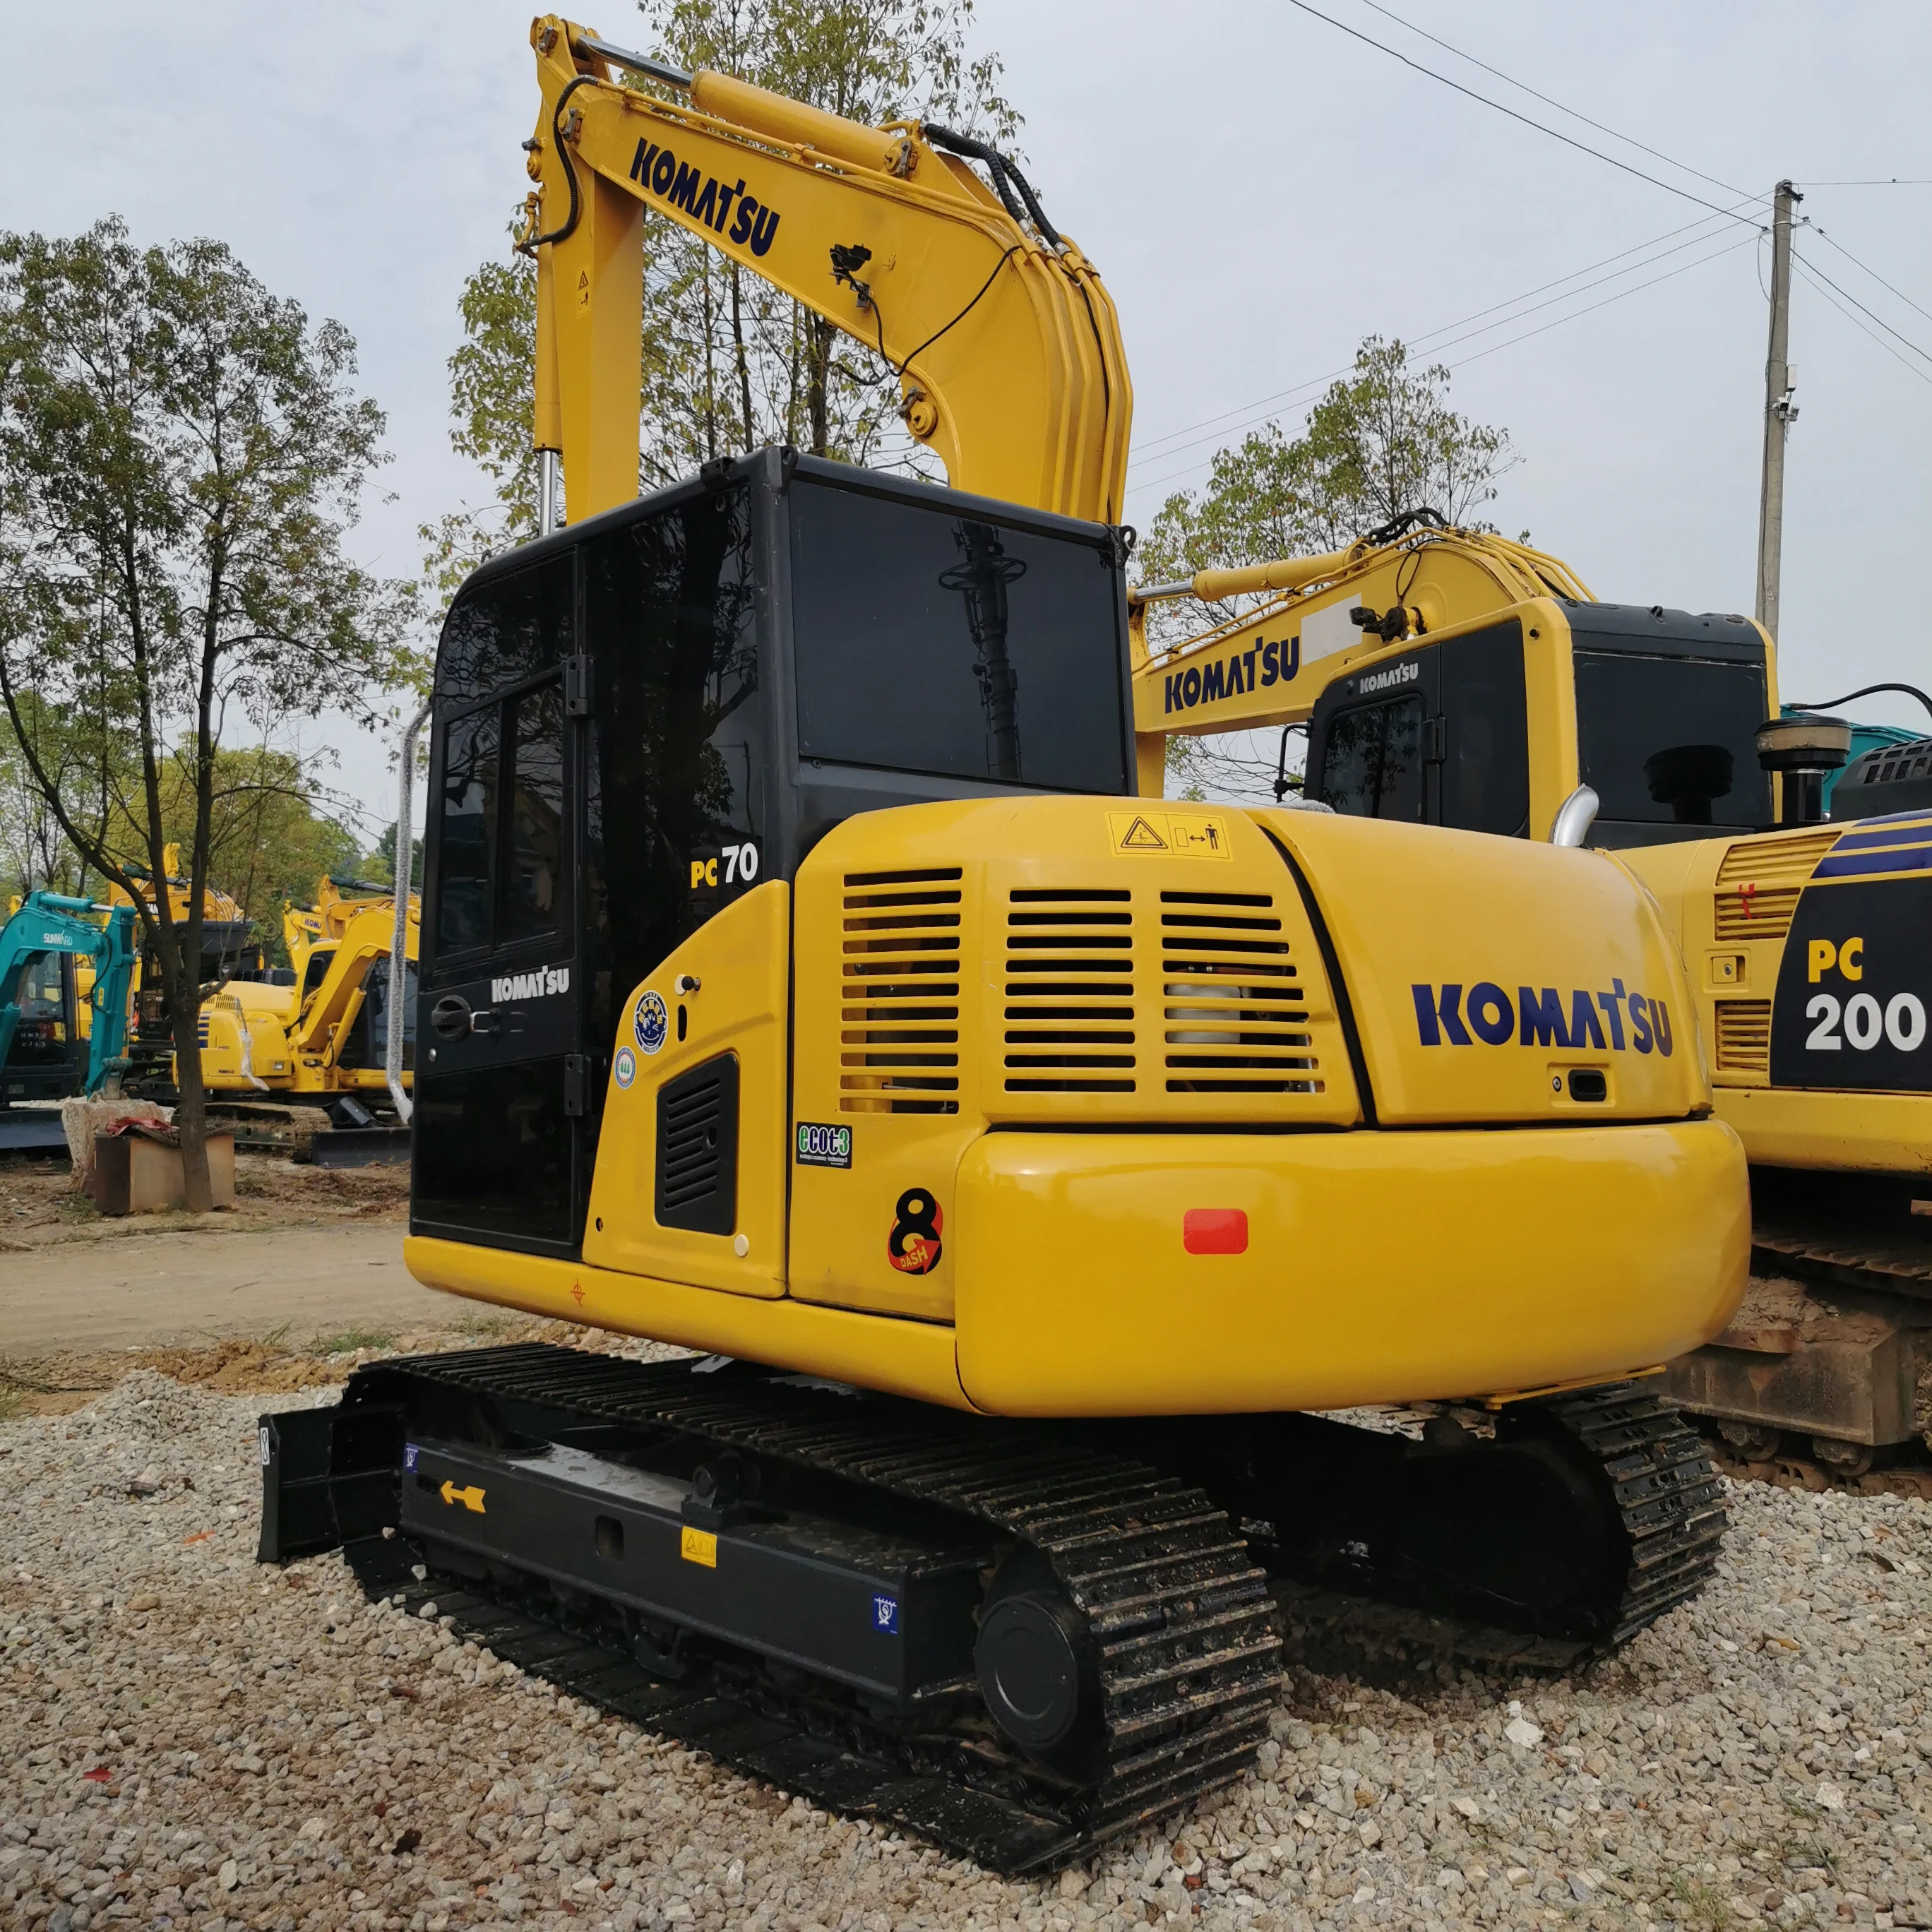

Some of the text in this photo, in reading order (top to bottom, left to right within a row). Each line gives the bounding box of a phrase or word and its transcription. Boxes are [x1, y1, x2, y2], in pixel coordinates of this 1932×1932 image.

[629, 136, 780, 256] KOMATSU
[1165, 636, 1299, 714] KOMATSU
[1360, 662, 1419, 694] KOMATSU
[691, 842, 758, 888] PC 70
[44, 929, 73, 946] SUNWARD
[1808, 936, 1864, 983] PC
[491, 965, 570, 1003] KOMATSU
[1410, 977, 1674, 1057] KOMATSU
[1805, 992, 1926, 1051] 200
[799, 1126, 849, 1156] ecot3
[889, 1187, 943, 1276] 8
[900, 1245, 929, 1268] DASH
